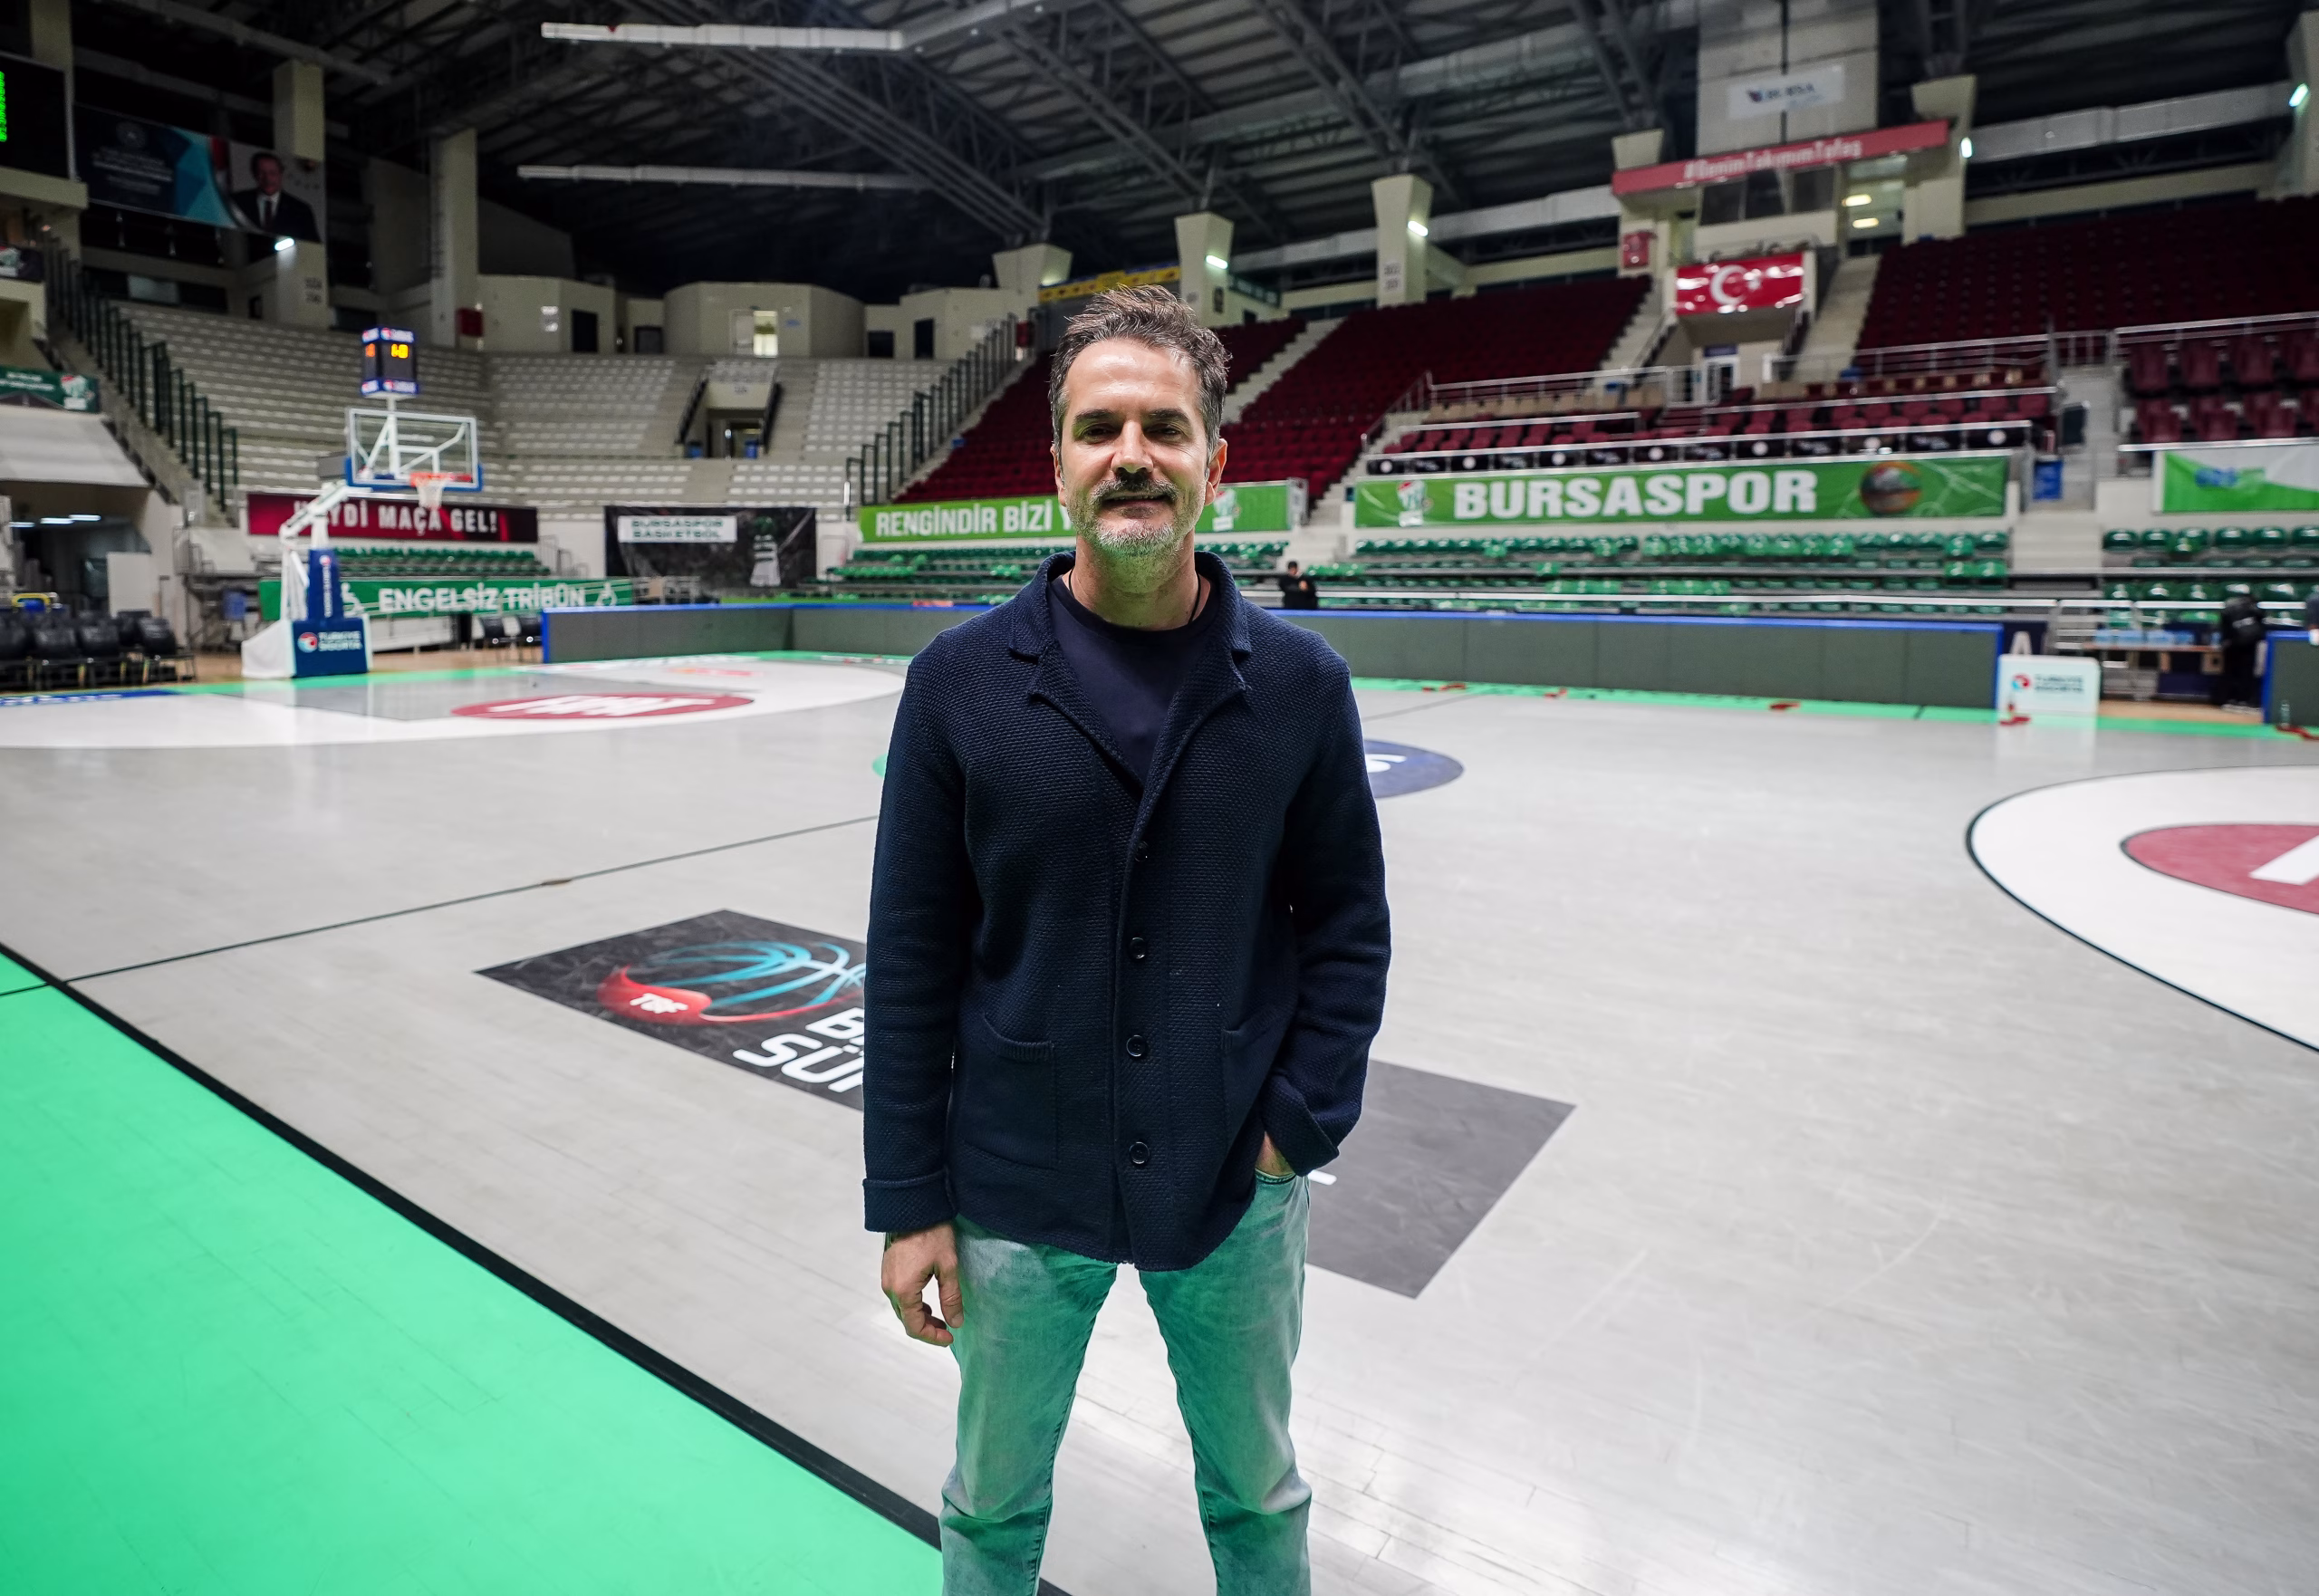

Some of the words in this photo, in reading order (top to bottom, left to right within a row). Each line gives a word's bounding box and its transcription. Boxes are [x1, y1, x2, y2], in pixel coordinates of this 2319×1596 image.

[1453, 469, 1818, 520] BURSASPOR
[377, 505, 442, 536] MAÇA
[449, 508, 497, 534] GEL!
[875, 503, 997, 537] RENGİNDİR
[1002, 499, 1053, 533] BİZİ
[378, 582, 499, 613] ENGELSİZ
[502, 582, 586, 611] TRİBÜN
